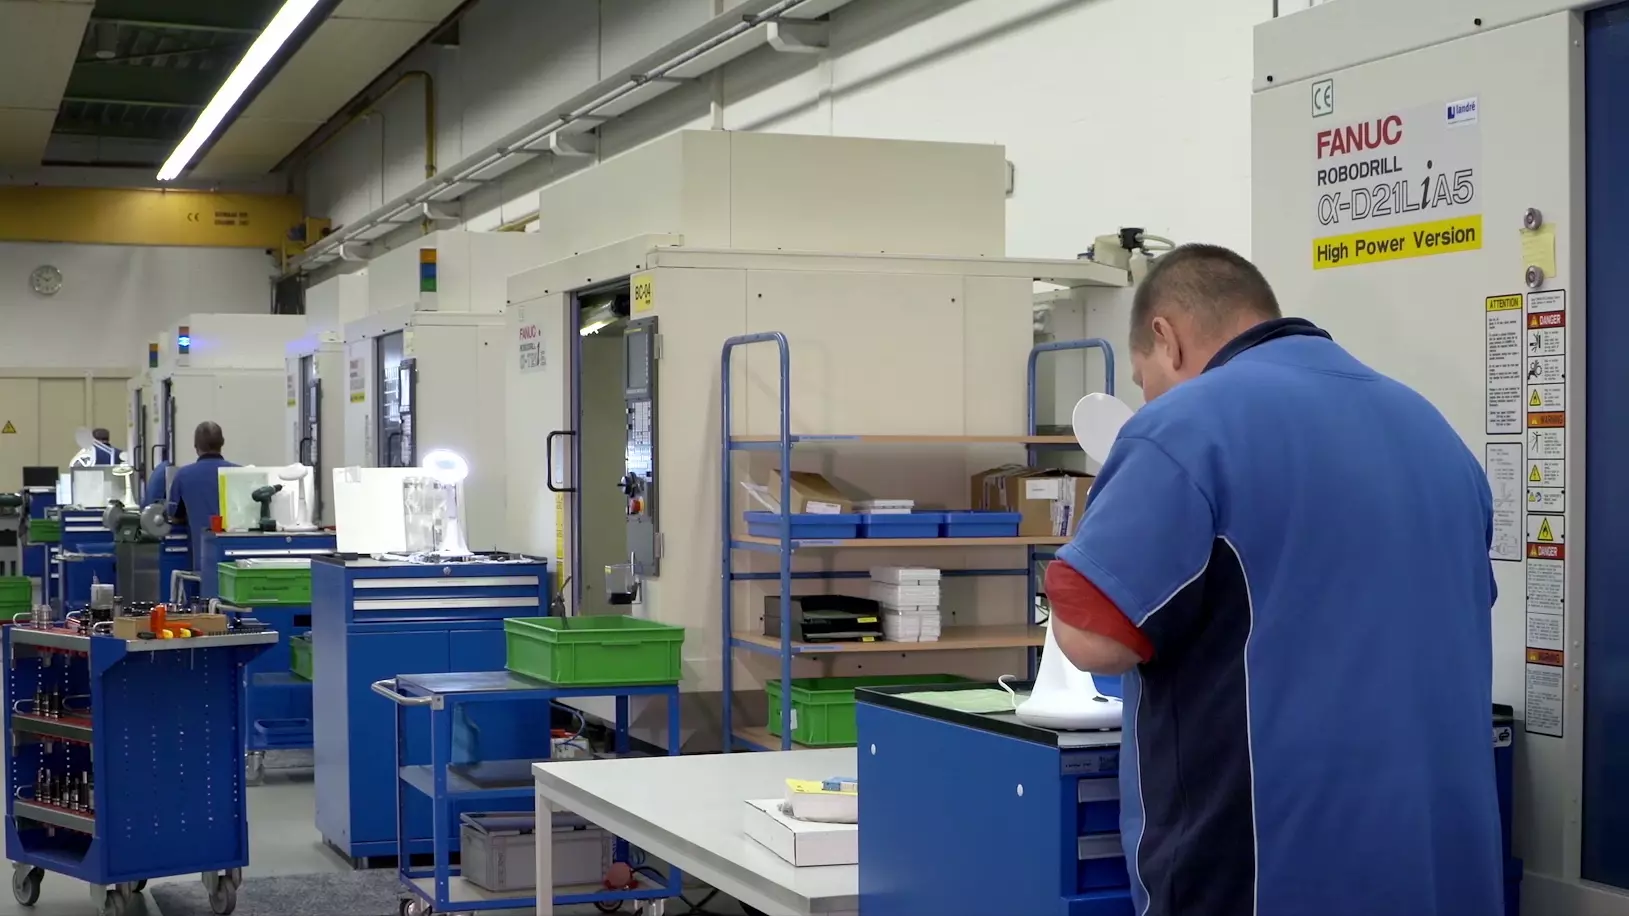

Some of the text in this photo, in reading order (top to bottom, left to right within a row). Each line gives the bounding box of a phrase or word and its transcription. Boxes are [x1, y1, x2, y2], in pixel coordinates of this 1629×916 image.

[1456, 101, 1476, 114] landré
[1317, 115, 1403, 159] FANUC
[1317, 156, 1403, 186] ROBODRILL
[1317, 226, 1475, 263] High Power Version
[635, 282, 651, 300] BC-04
[1489, 298, 1519, 309] ATTENTION
[1539, 314, 1561, 326] DANGER
[519, 324, 537, 340] FANUC
